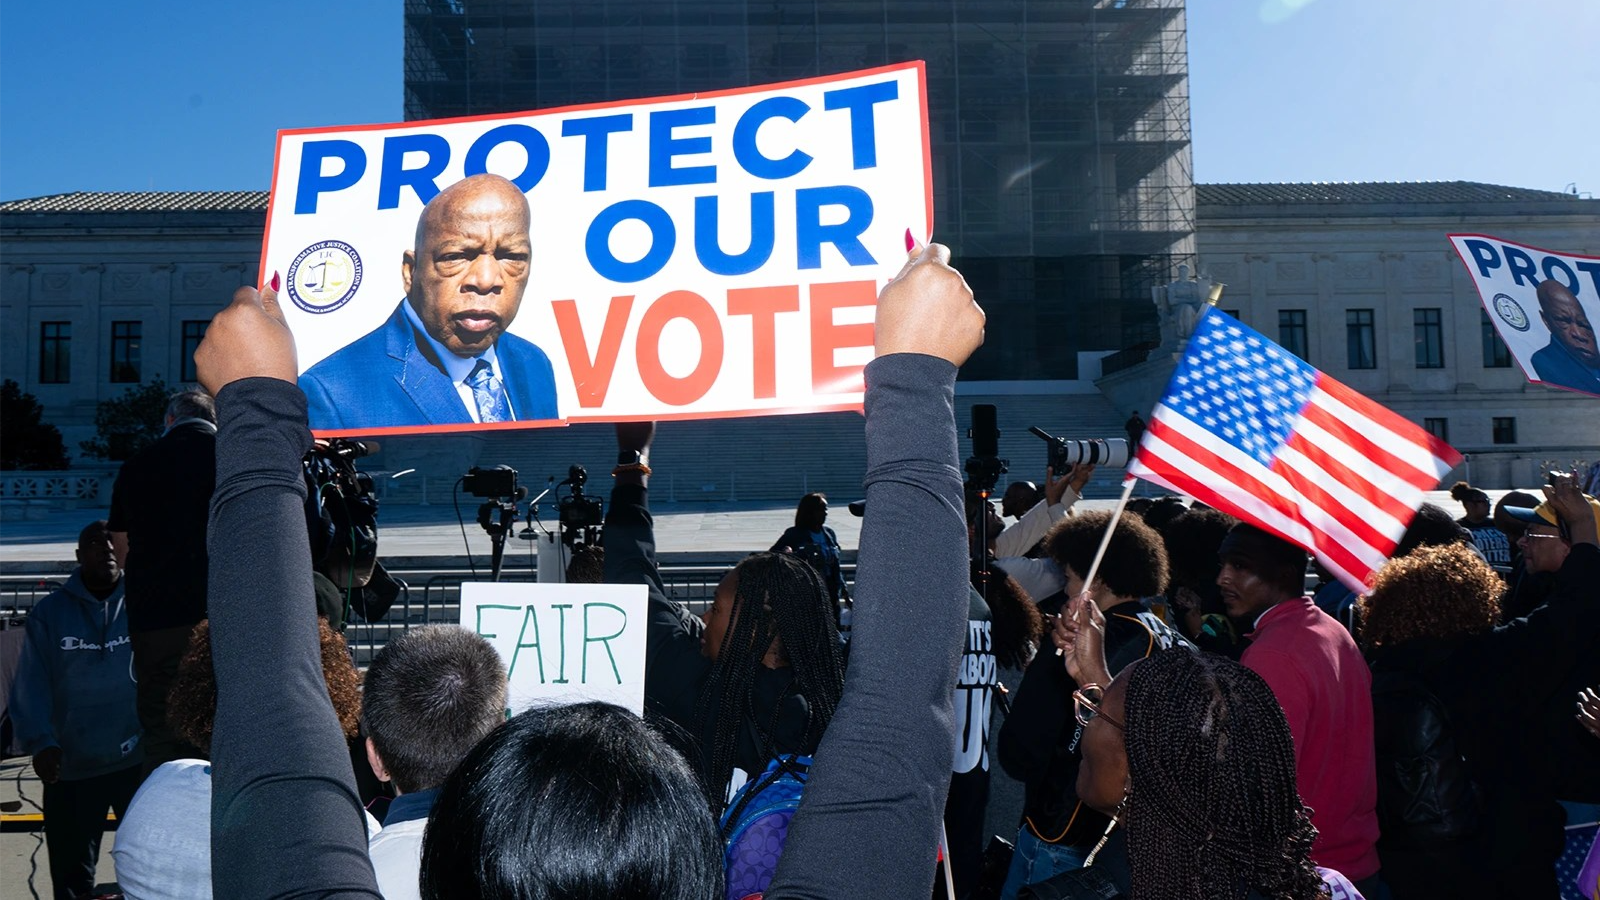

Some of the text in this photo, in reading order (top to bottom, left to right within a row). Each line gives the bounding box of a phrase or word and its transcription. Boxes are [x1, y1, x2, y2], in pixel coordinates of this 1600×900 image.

[294, 80, 899, 215] PROTECT
[288, 242, 361, 290] TRANSFORMATIVE JUSTICE COALITION
[585, 185, 878, 284] OUR
[551, 278, 893, 408] VOTE
[1475, 537, 1510, 551] OTERS
[476, 602, 627, 685] FAIR
[969, 620, 992, 652] IT'S
